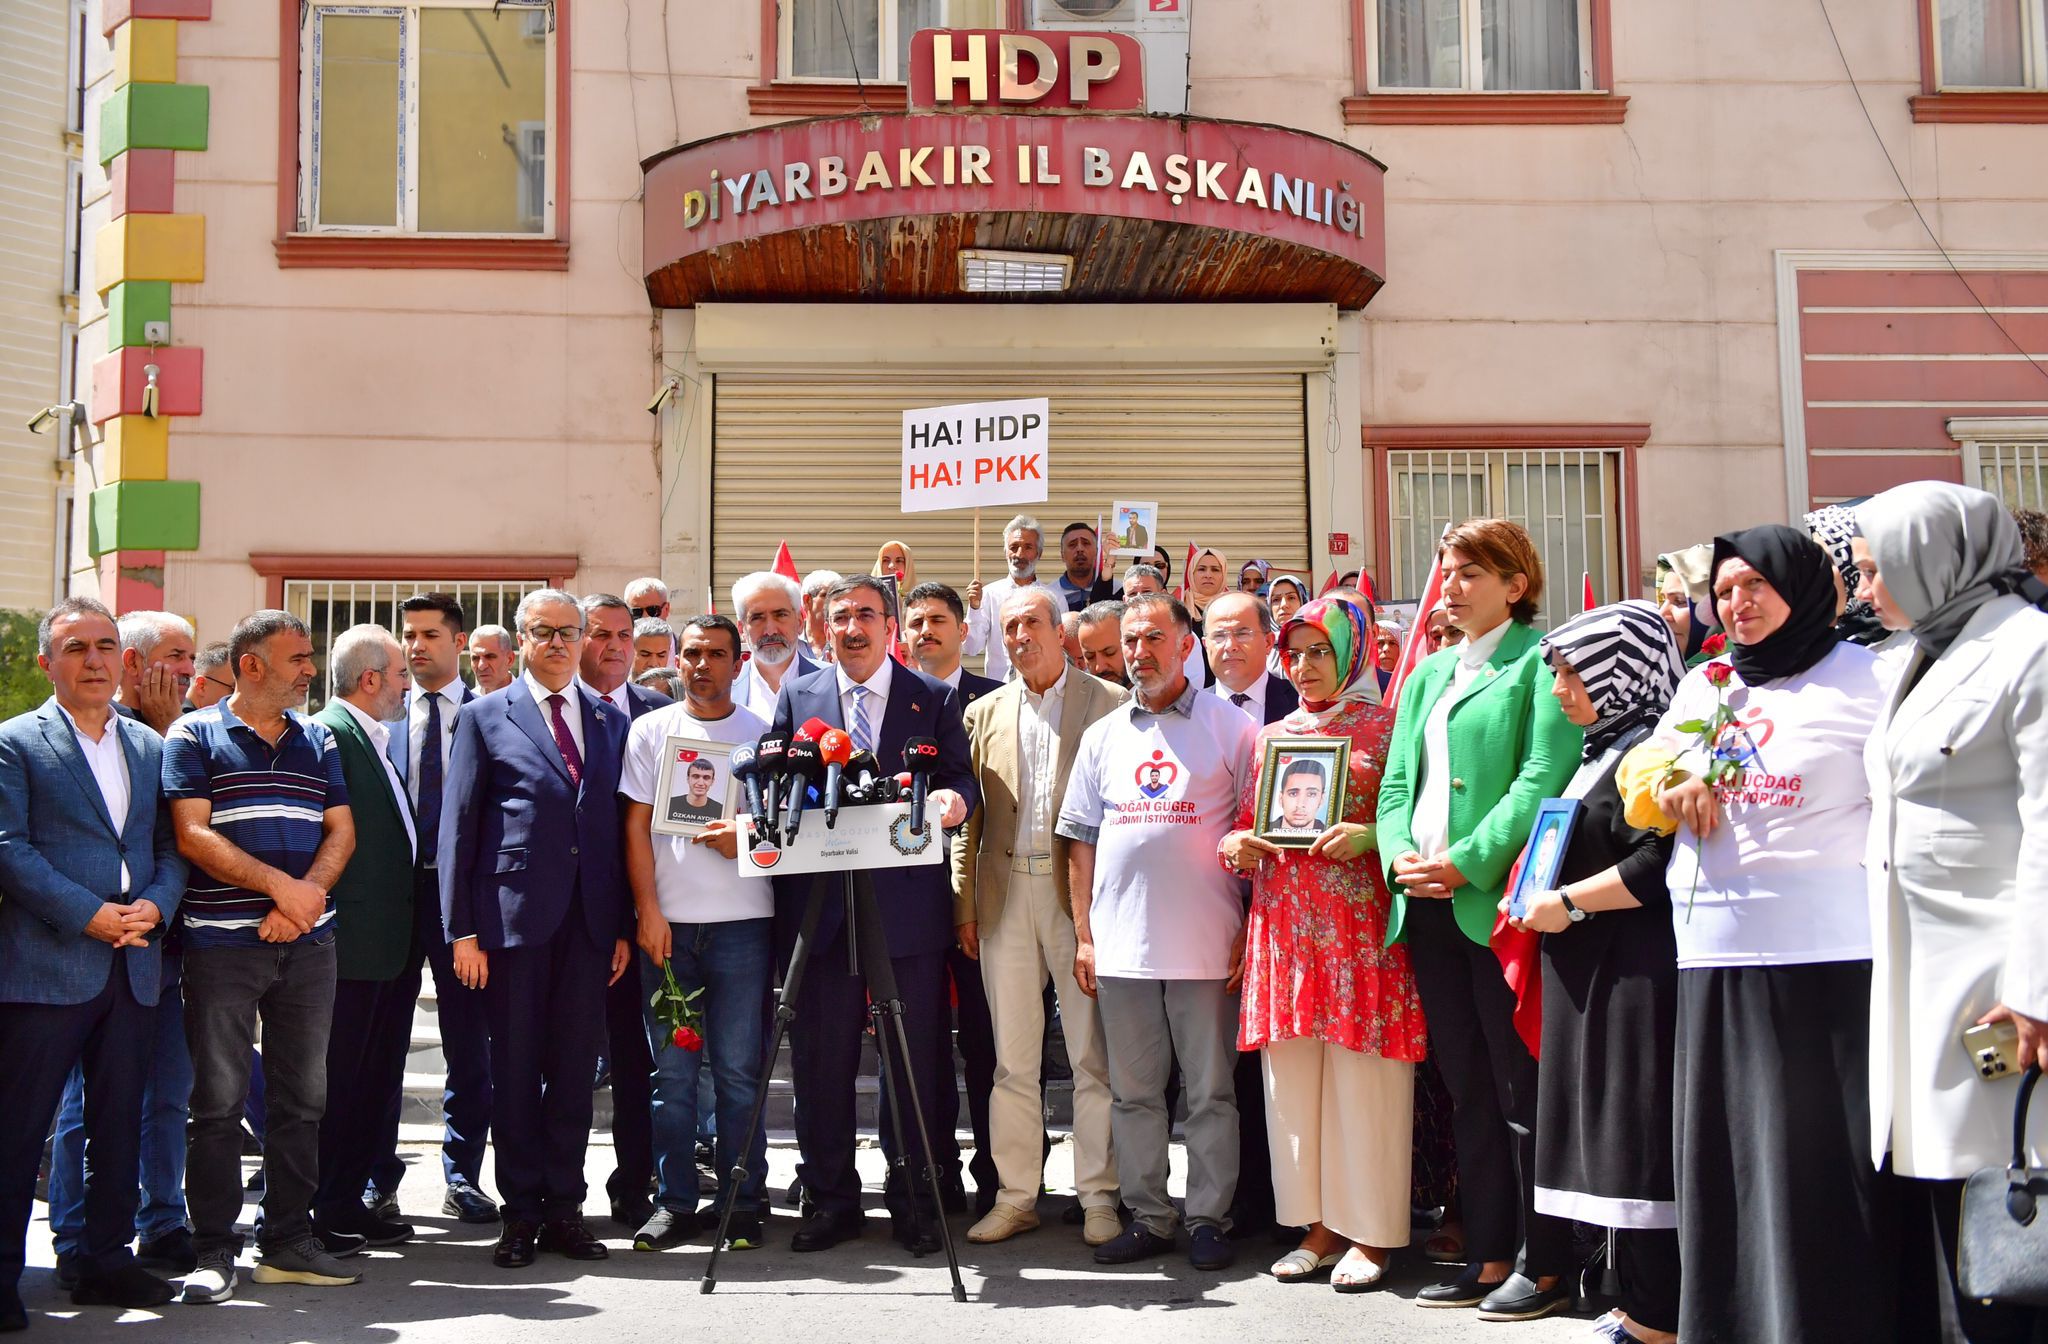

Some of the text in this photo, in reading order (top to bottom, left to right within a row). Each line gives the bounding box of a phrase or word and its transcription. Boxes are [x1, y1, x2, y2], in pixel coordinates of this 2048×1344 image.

[934, 34, 1120, 104] HDP
[683, 145, 994, 229] DİYARBAKIR
[1084, 147, 1365, 239] BAŞKANLIĞI
[910, 413, 1041, 449] HA! HDP
[909, 453, 1041, 489] HA! PKK
[761, 740, 783, 749] TRT
[672, 811, 696, 820] ÖZKAN
